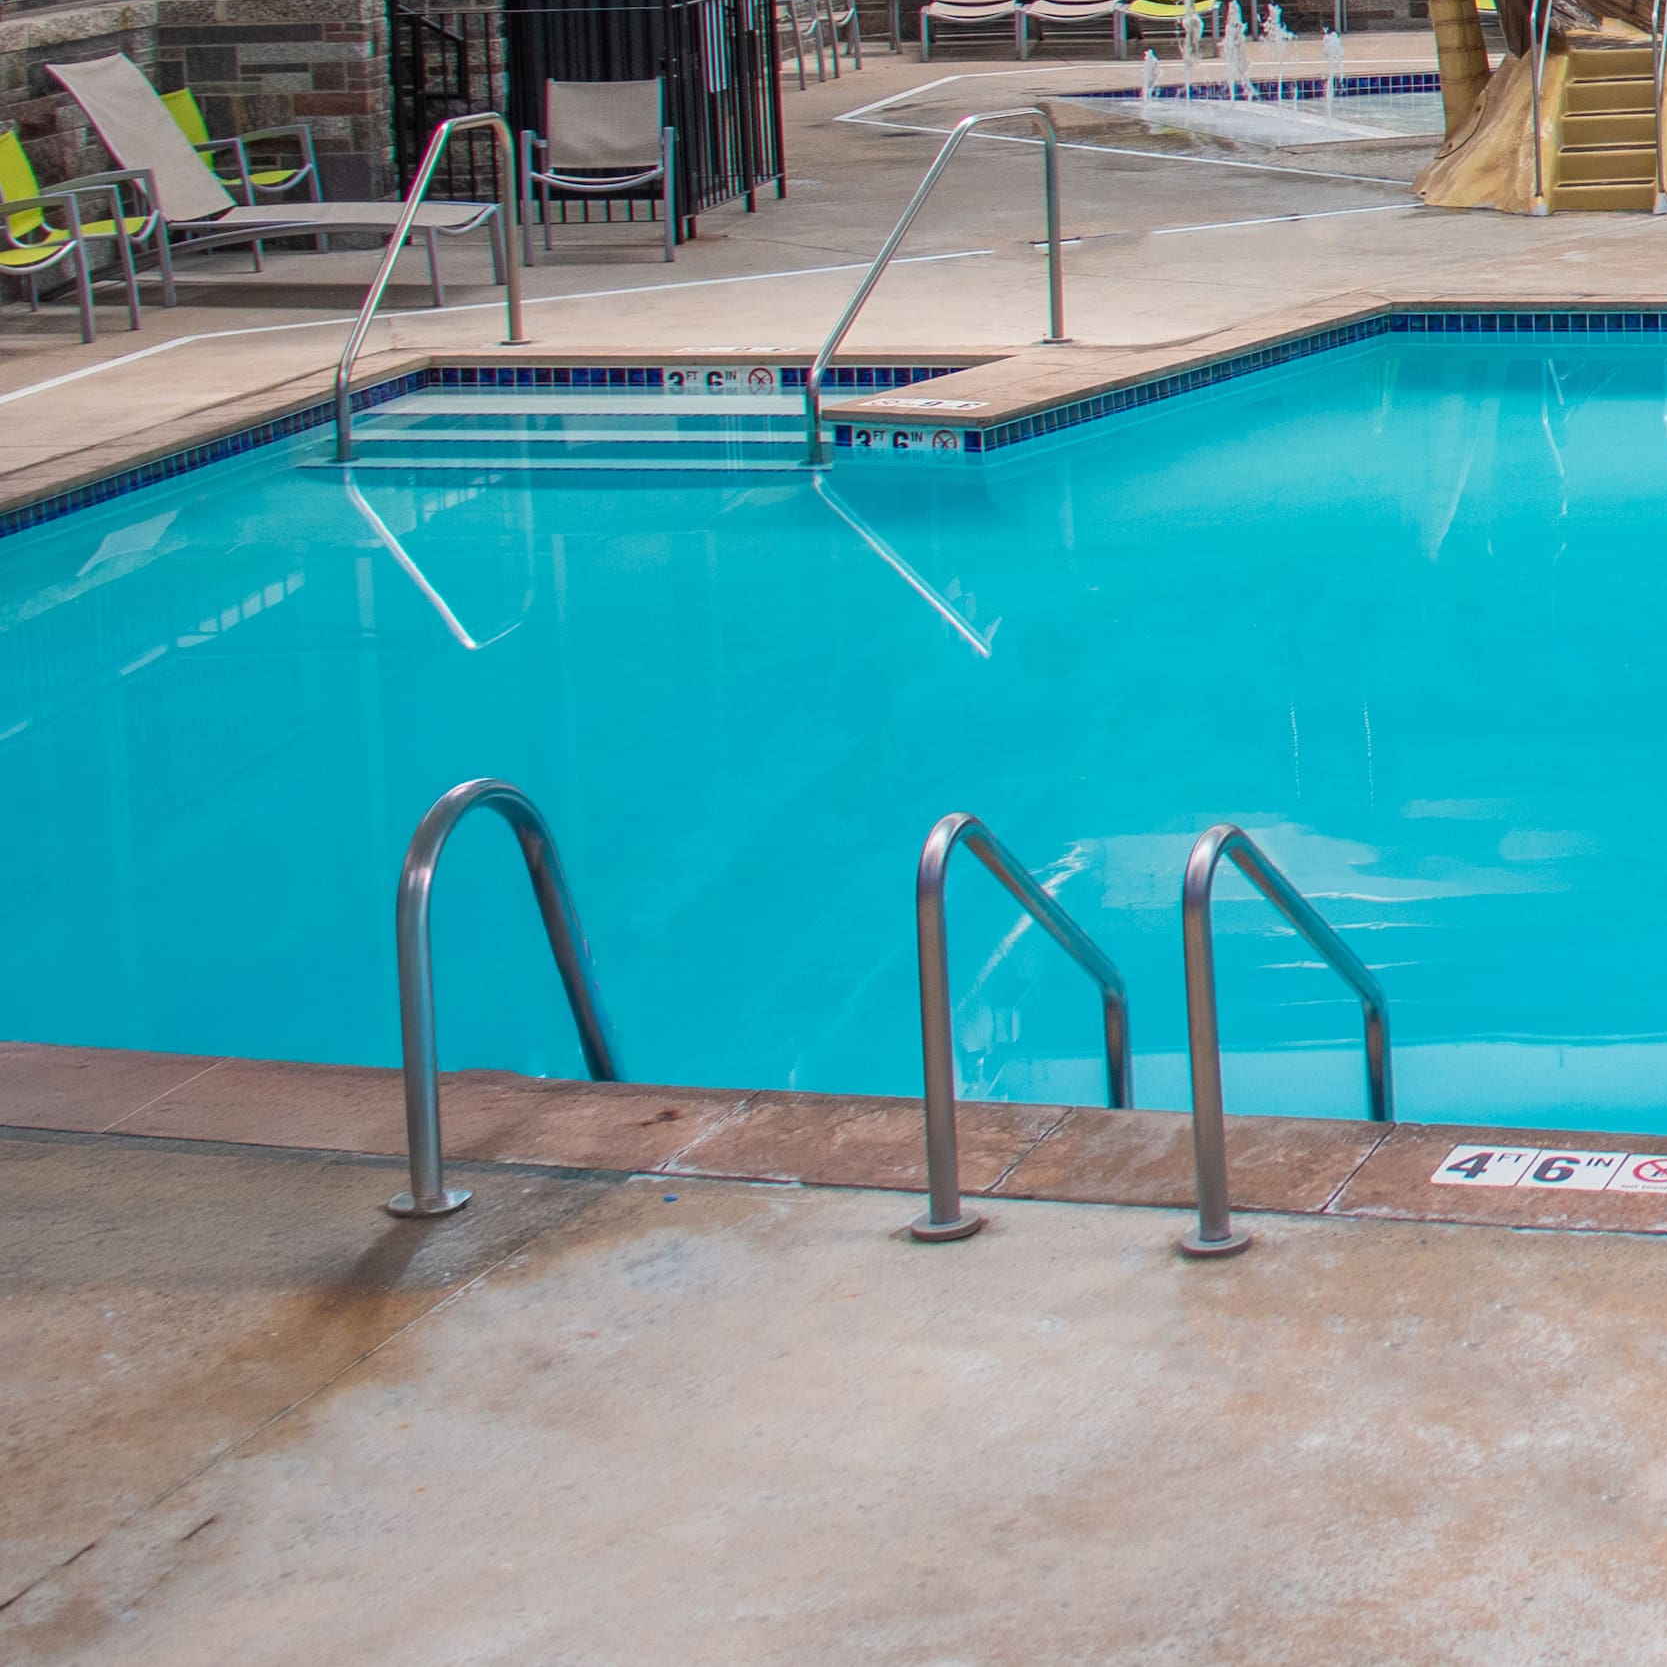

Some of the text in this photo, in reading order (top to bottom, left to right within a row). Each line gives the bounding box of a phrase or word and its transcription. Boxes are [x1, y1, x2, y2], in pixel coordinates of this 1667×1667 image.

[668, 371, 736, 386] 3 FT 6 IN
[857, 430, 922, 448] 3 FT 6 IN
[1445, 1152, 1615, 1182] 4 FT 6 IN
